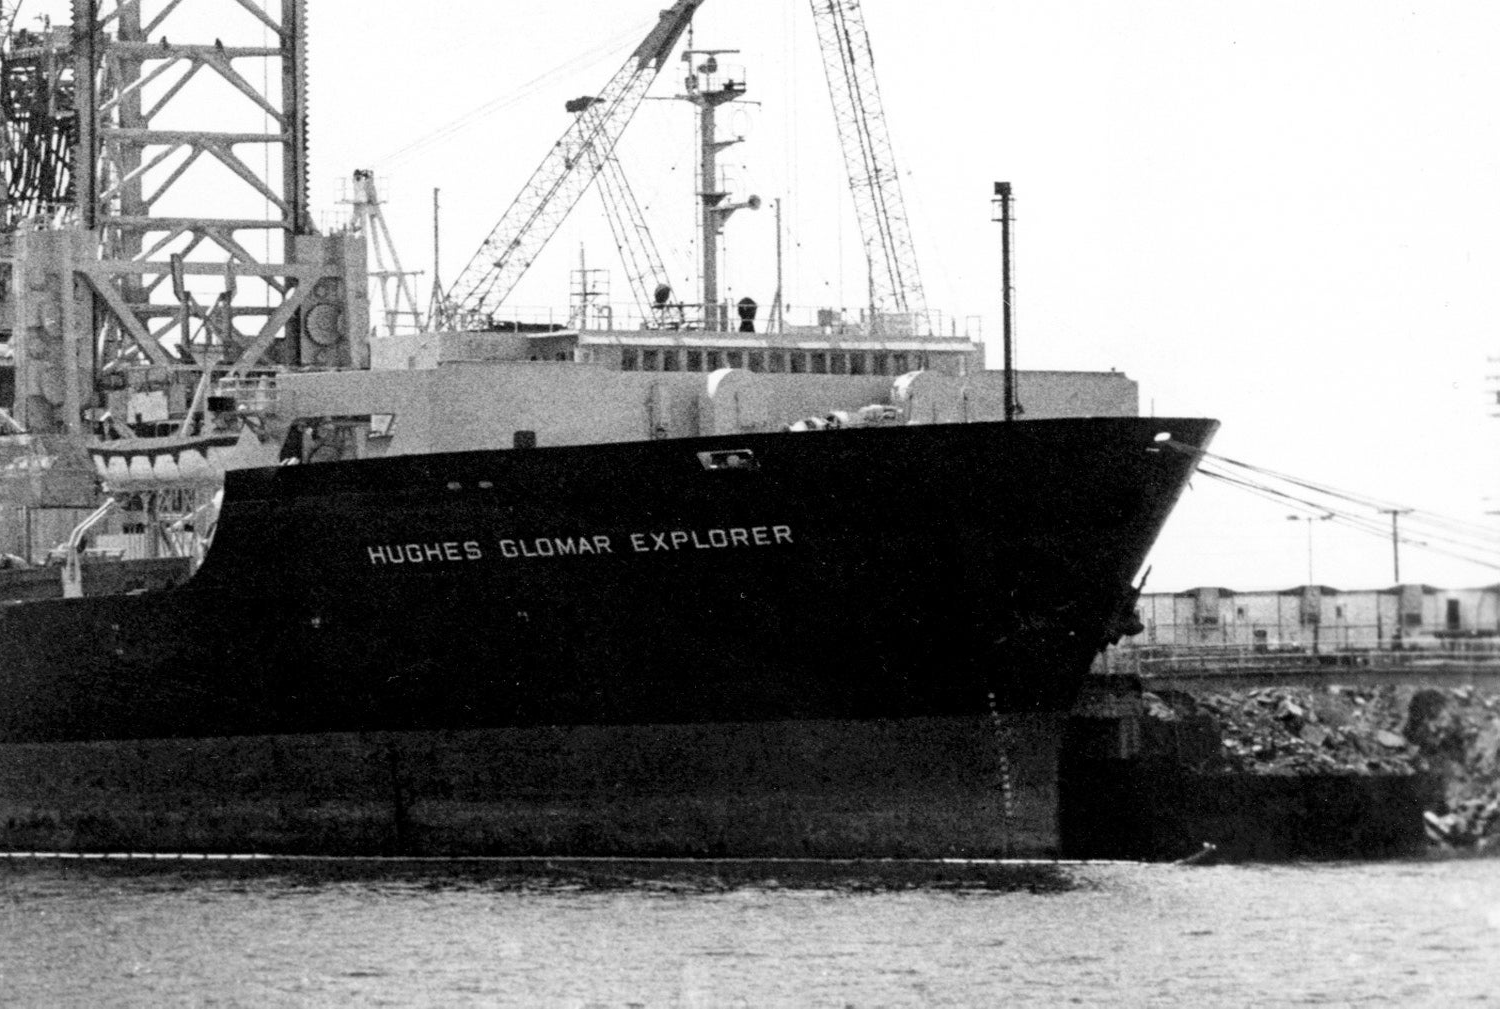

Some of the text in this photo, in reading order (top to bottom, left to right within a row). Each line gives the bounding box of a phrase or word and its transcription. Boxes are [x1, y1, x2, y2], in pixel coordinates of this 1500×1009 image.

[367, 525, 794, 565] HUGHES GLOMAR EXPLORER
